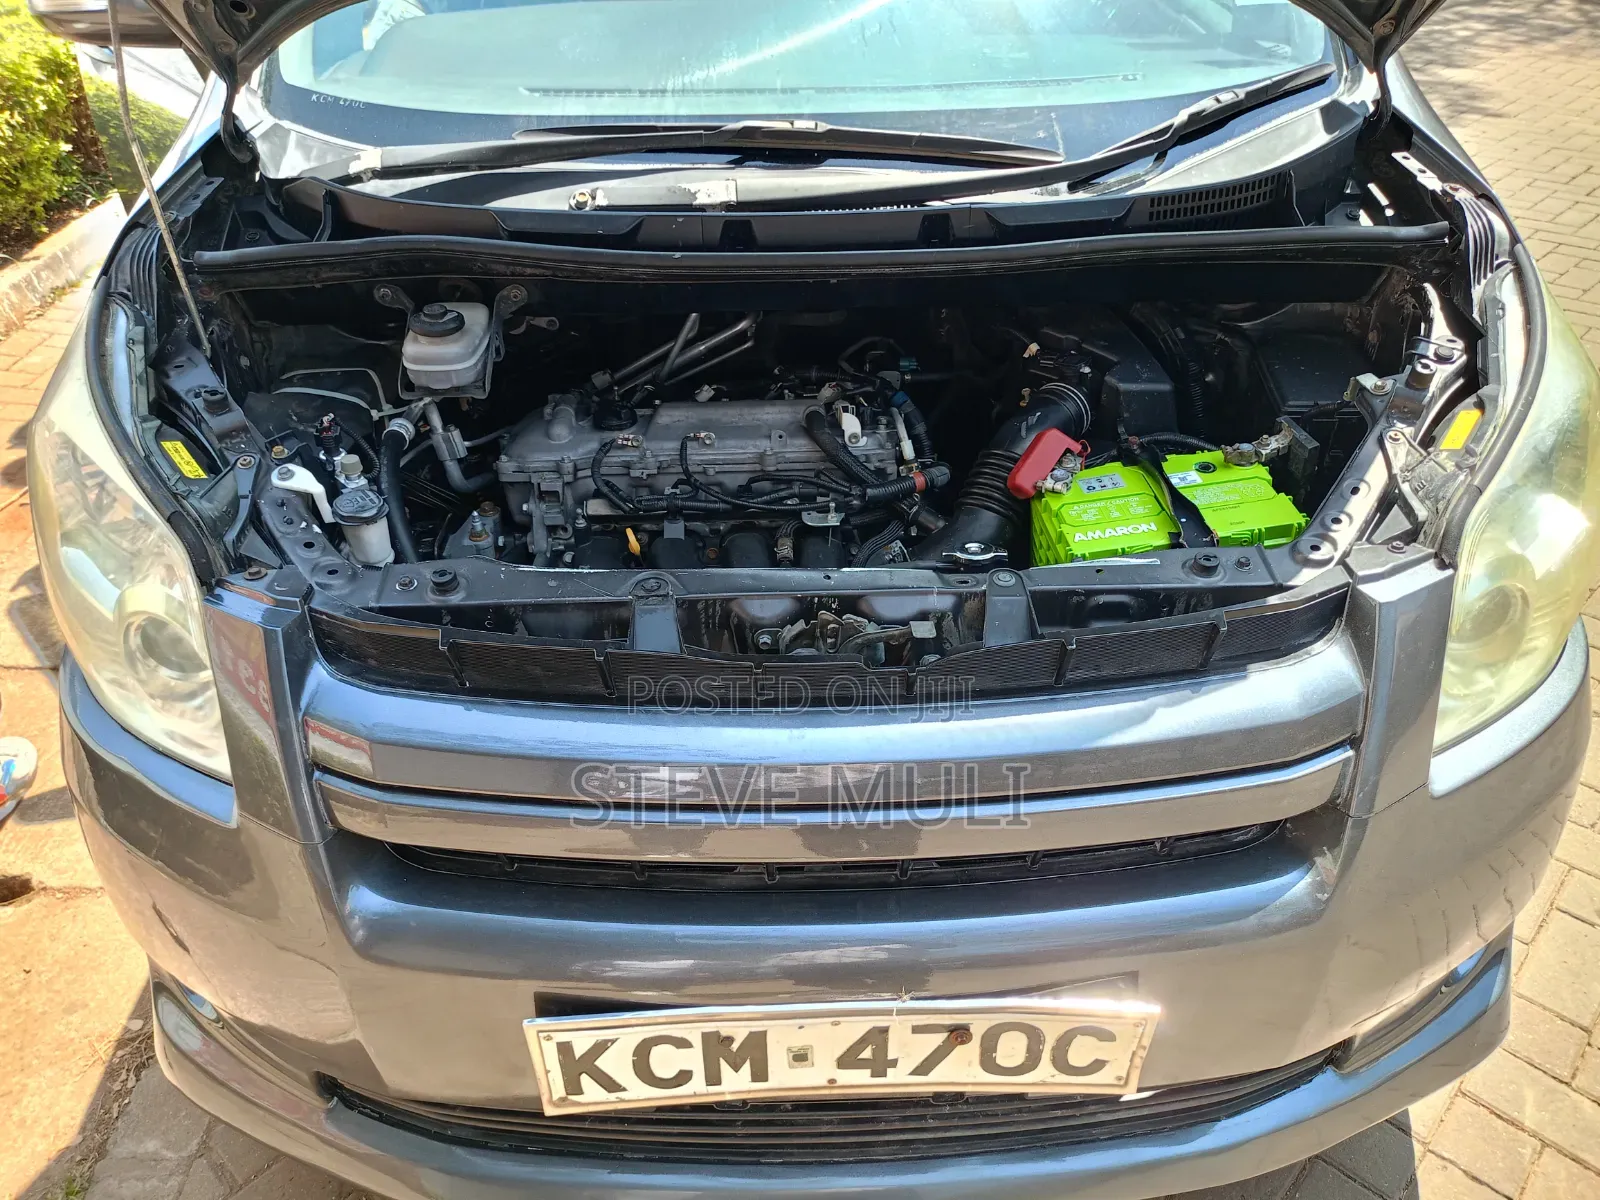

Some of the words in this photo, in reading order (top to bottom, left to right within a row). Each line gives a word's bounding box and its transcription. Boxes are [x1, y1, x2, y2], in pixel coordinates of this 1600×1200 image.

[311, 93, 335, 104] KCM
[1073, 522, 1158, 542] AMARON
[555, 1029, 769, 1096] KCM
[835, 1021, 1118, 1078] 470C
